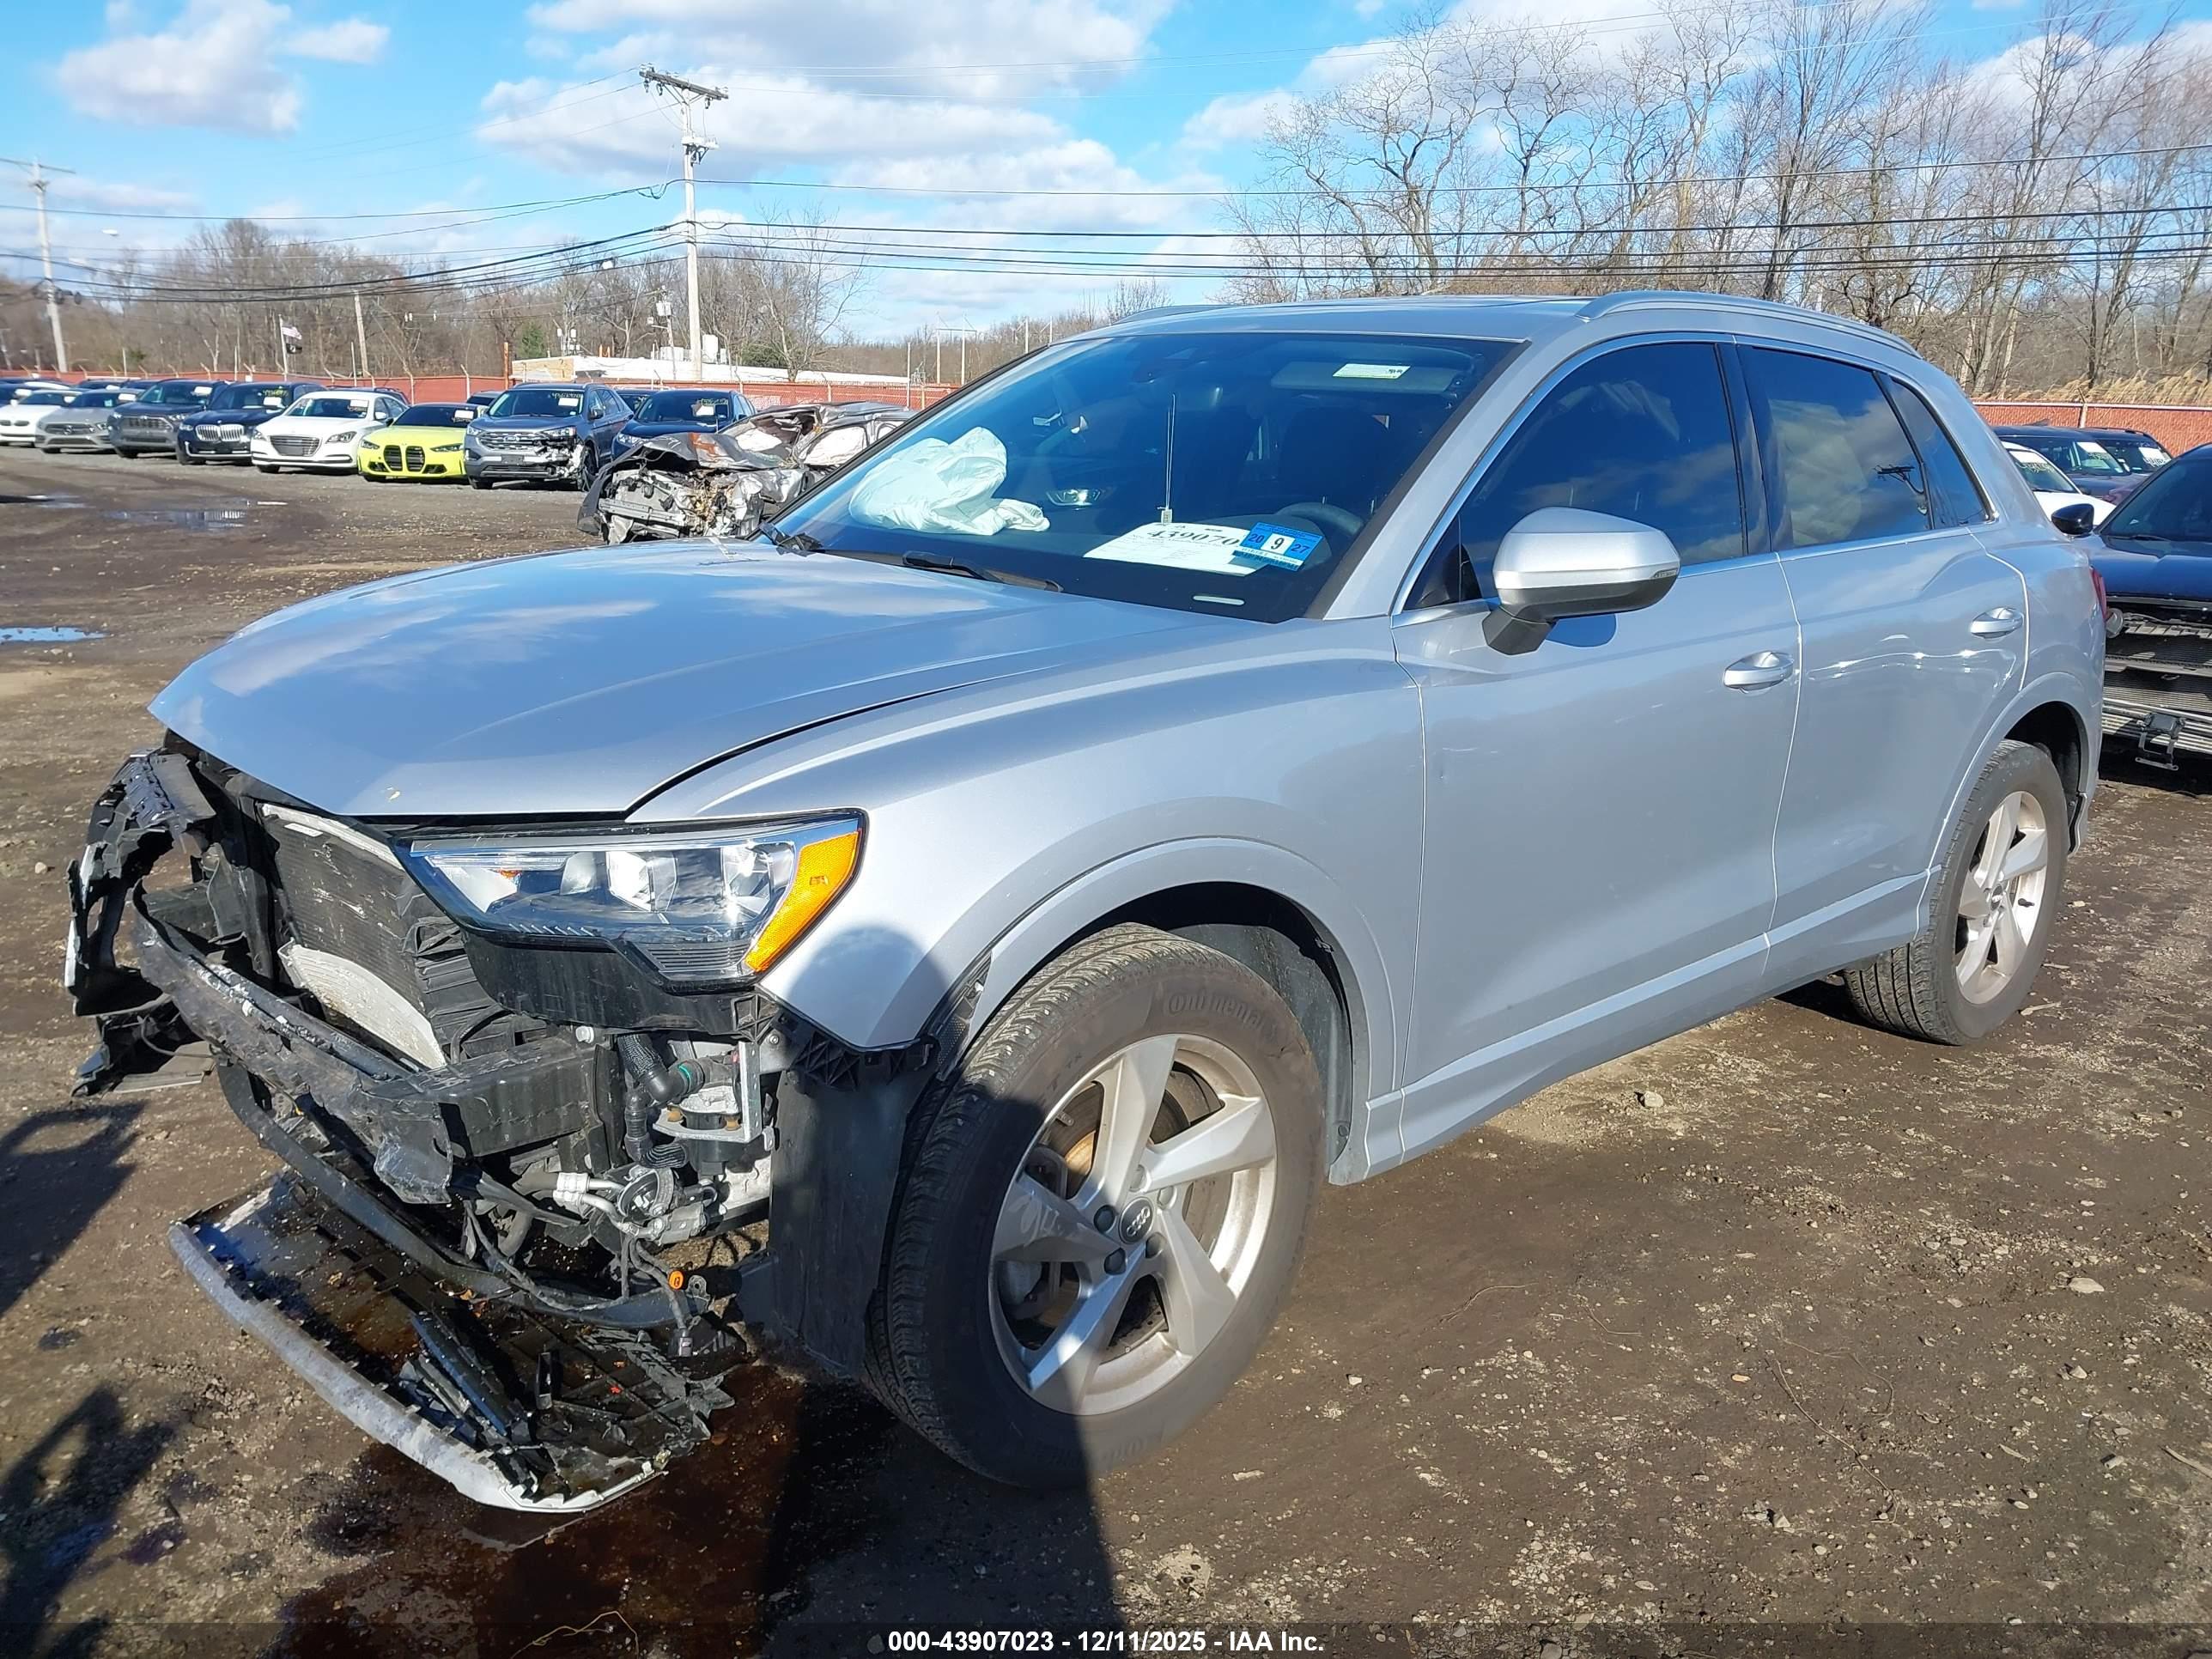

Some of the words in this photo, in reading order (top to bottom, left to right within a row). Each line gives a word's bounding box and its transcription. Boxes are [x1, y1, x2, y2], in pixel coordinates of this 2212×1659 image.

[1248, 533, 1265, 544] 20
[1270, 537, 1285, 550] 9
[1291, 544, 1310, 554] 27
